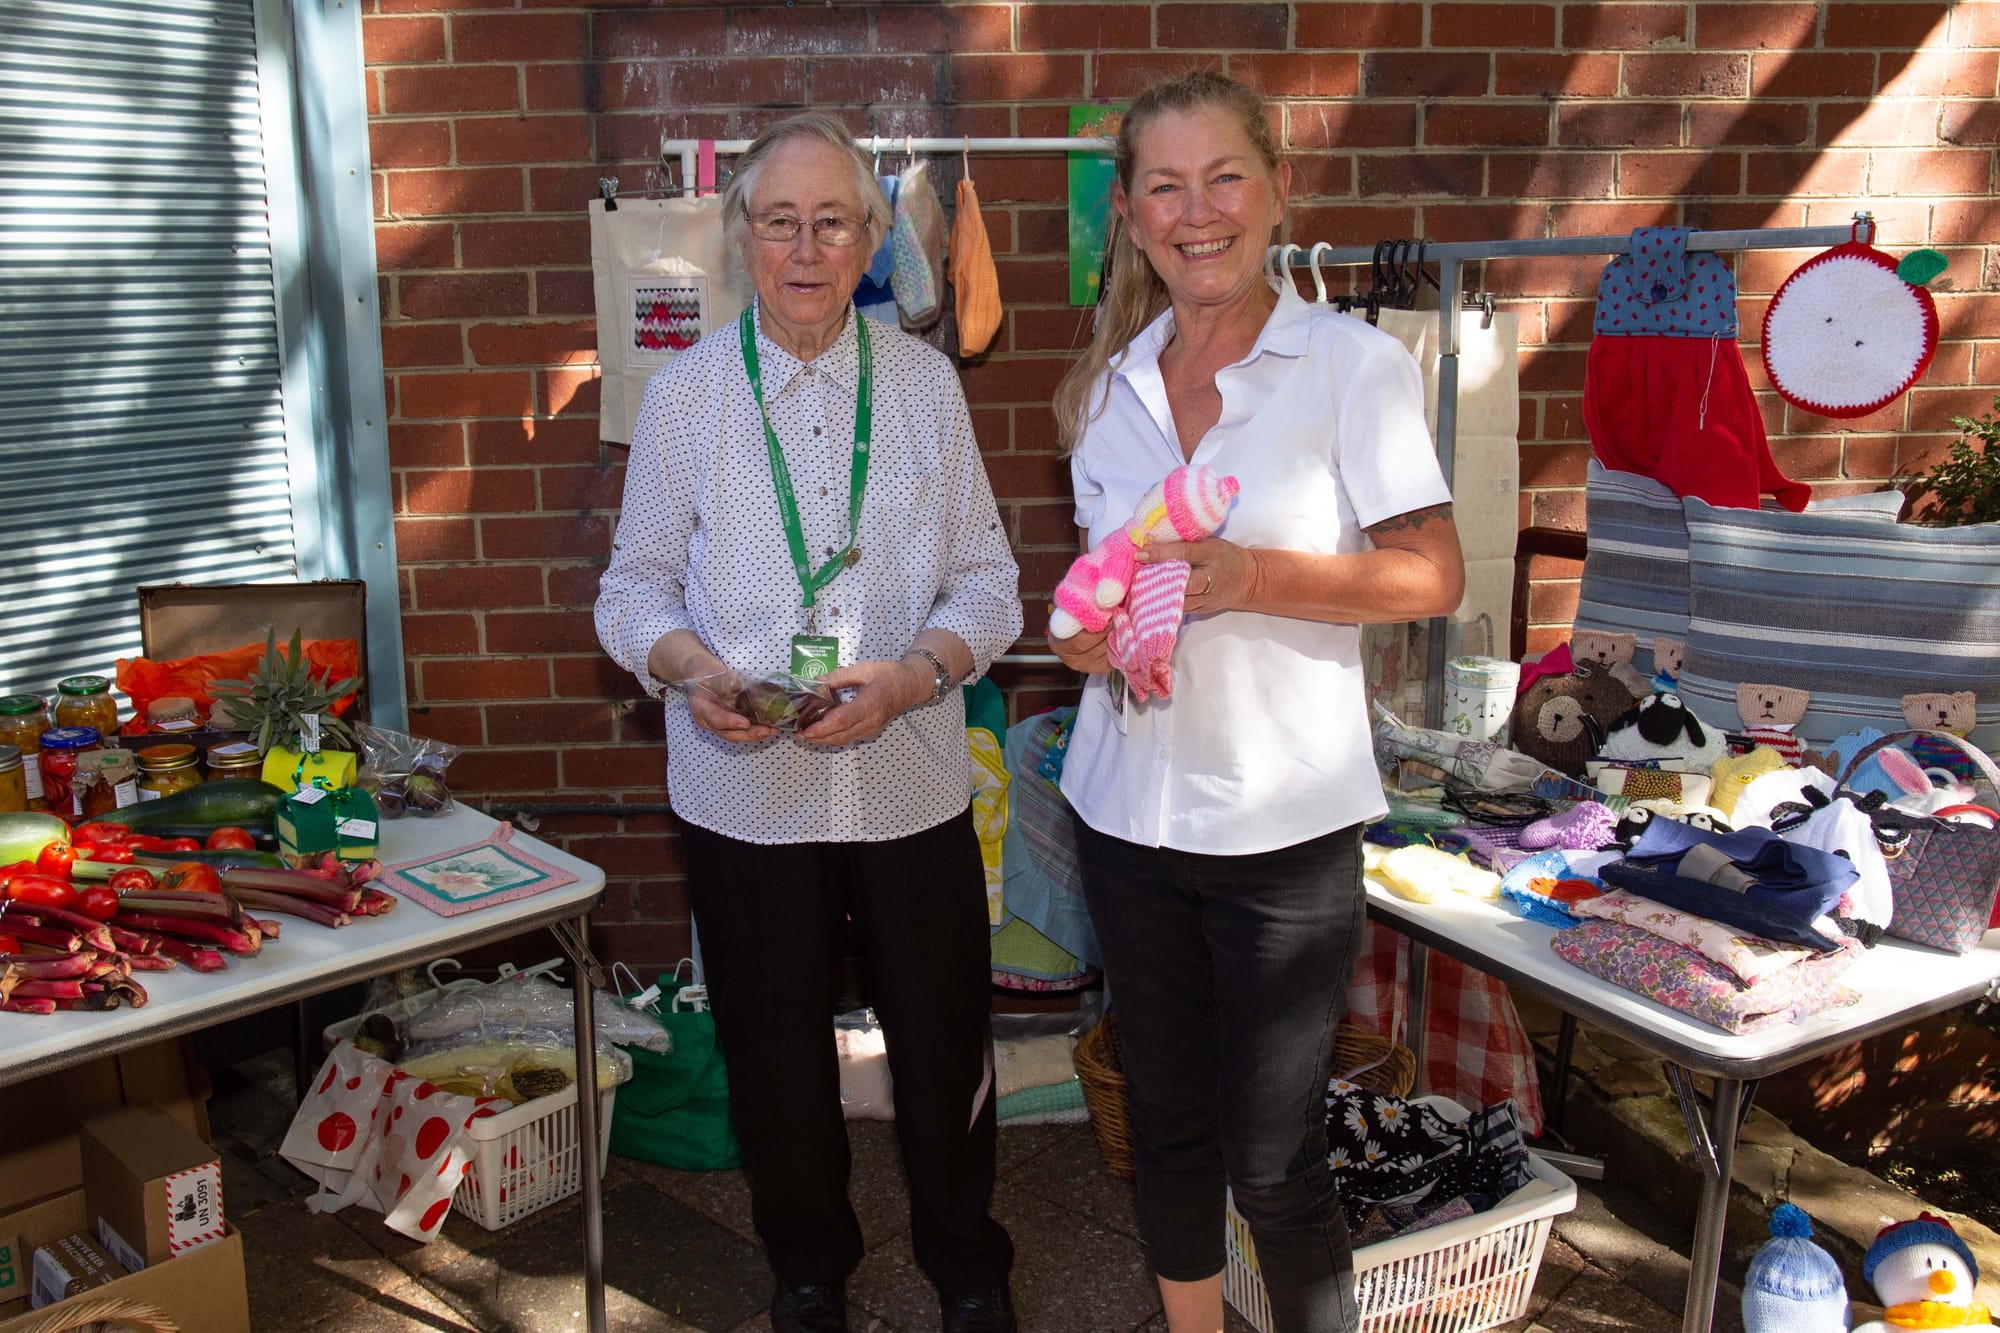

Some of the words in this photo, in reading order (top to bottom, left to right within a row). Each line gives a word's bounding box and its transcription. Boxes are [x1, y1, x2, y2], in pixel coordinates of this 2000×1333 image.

[780, 461, 790, 488] VICTORIA
[779, 486, 789, 514] COUNTRY
[785, 488, 791, 496] OF
[196, 1179, 208, 1206] 3091
[199, 1208, 209, 1227] UN
[57, 1239, 88, 1267] EXPECTING
[87, 1265, 97, 1275] ME
[70, 1234, 93, 1255] YOU'VE
[87, 1252, 106, 1267] BEEN
